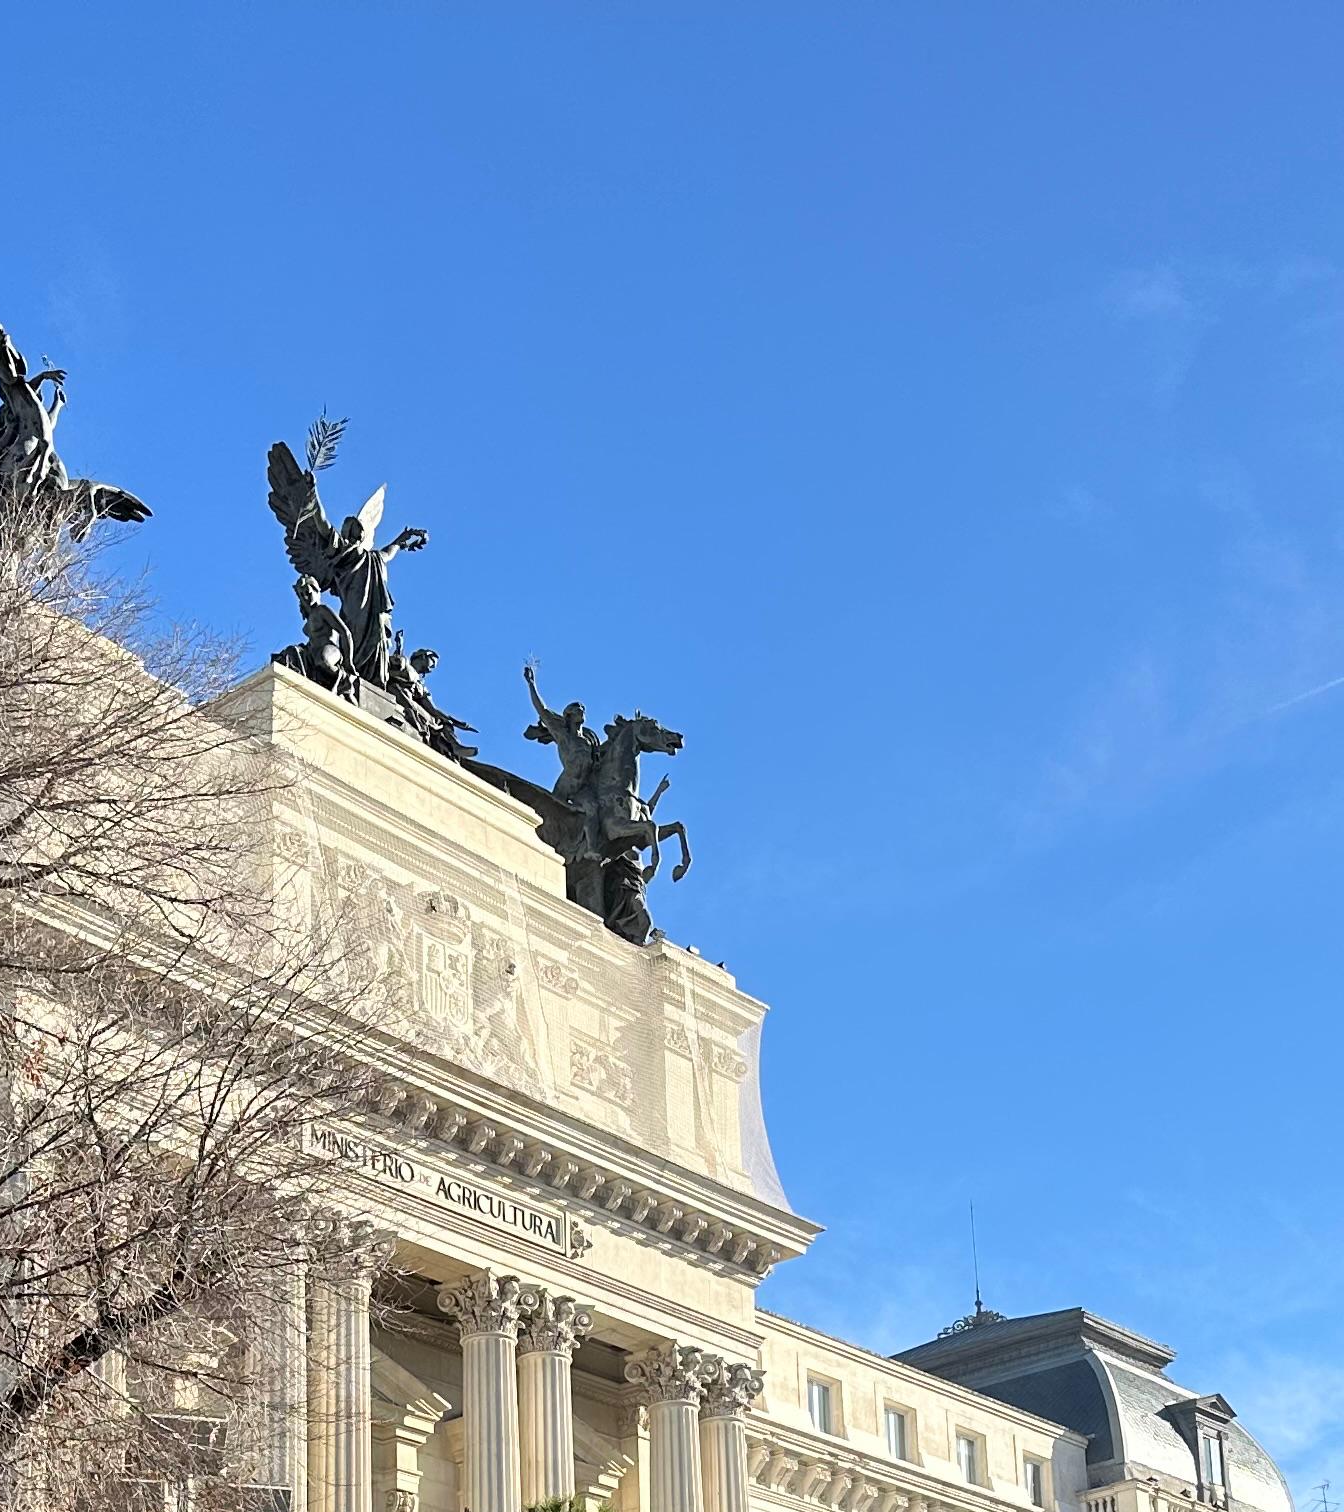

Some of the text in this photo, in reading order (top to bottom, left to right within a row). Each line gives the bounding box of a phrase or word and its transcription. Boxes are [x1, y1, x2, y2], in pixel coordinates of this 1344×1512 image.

[310, 1123, 557, 1244] MINISTERIO DE AGRICULTURA
